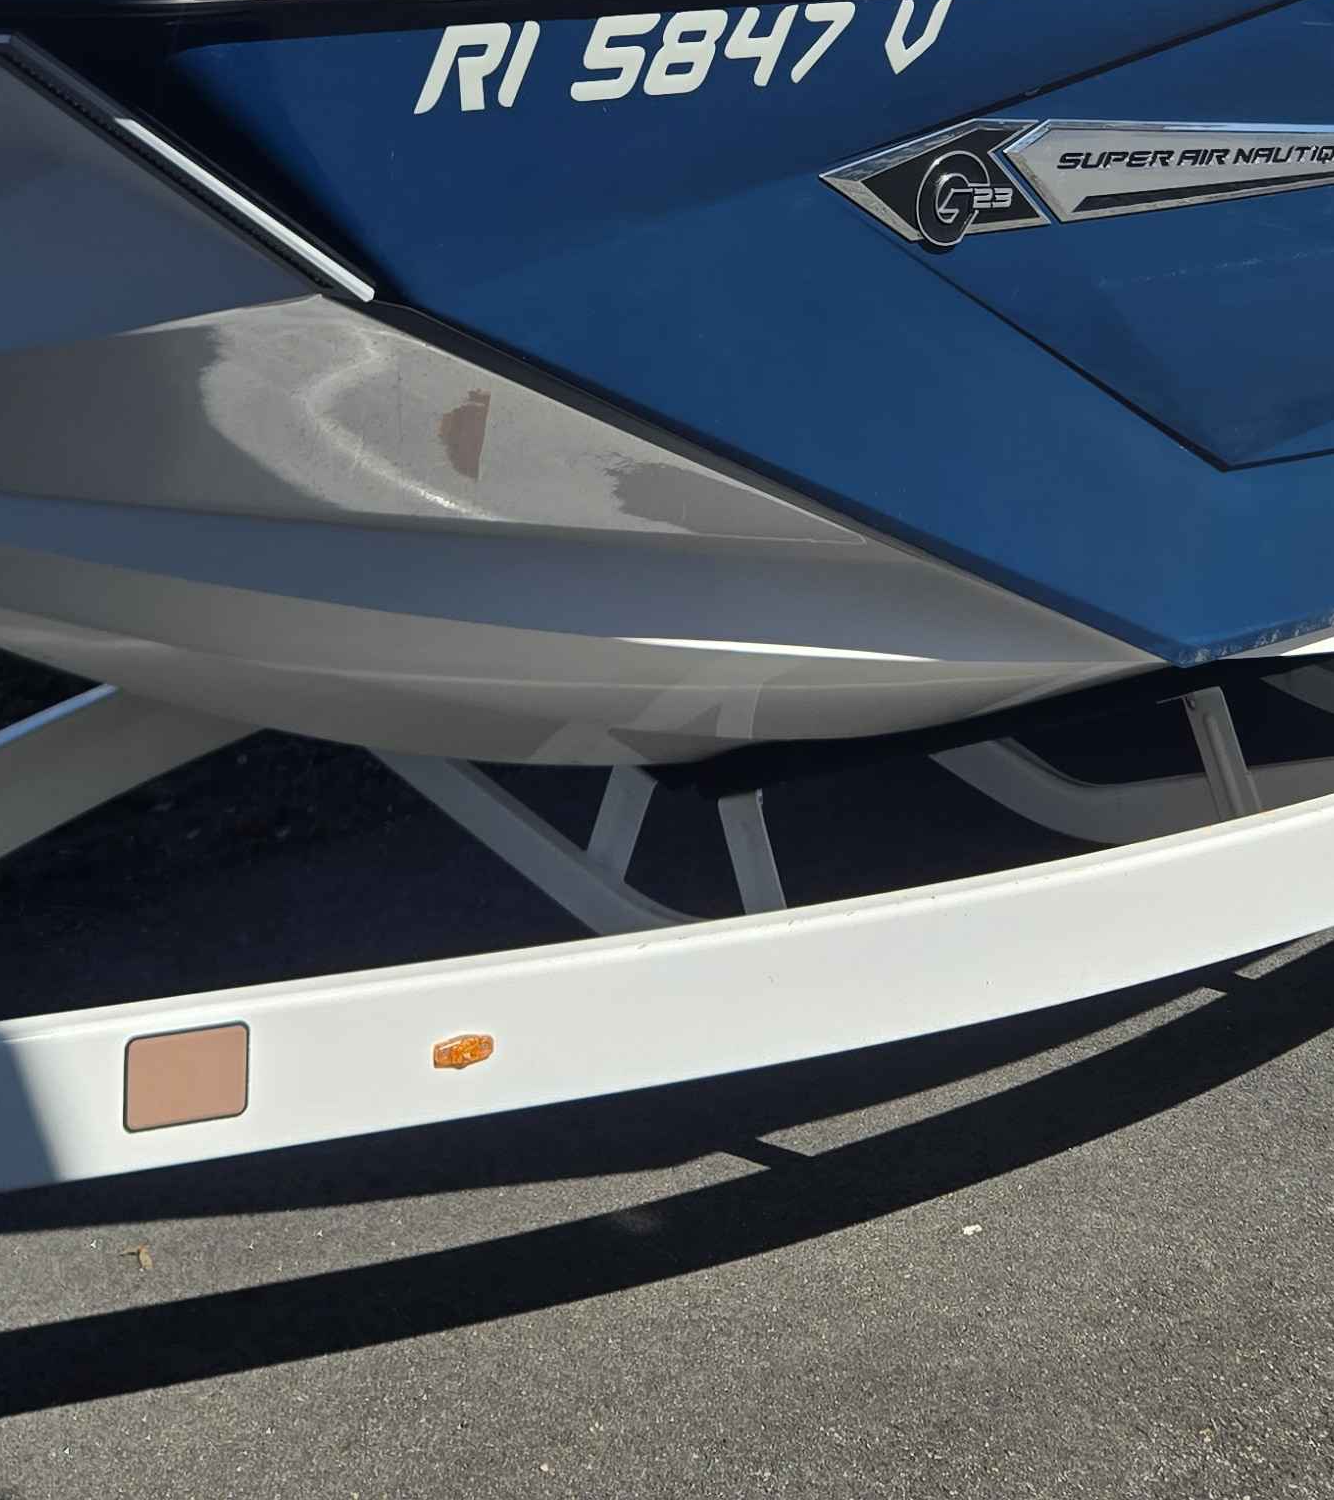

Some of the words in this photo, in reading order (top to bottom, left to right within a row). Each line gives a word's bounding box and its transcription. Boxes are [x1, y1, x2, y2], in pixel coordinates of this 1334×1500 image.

[413, 20, 540, 115] RI
[570, 1, 855, 102] 5847
[1057, 150, 1174, 169] SUPER
[1177, 148, 1230, 166] AIR
